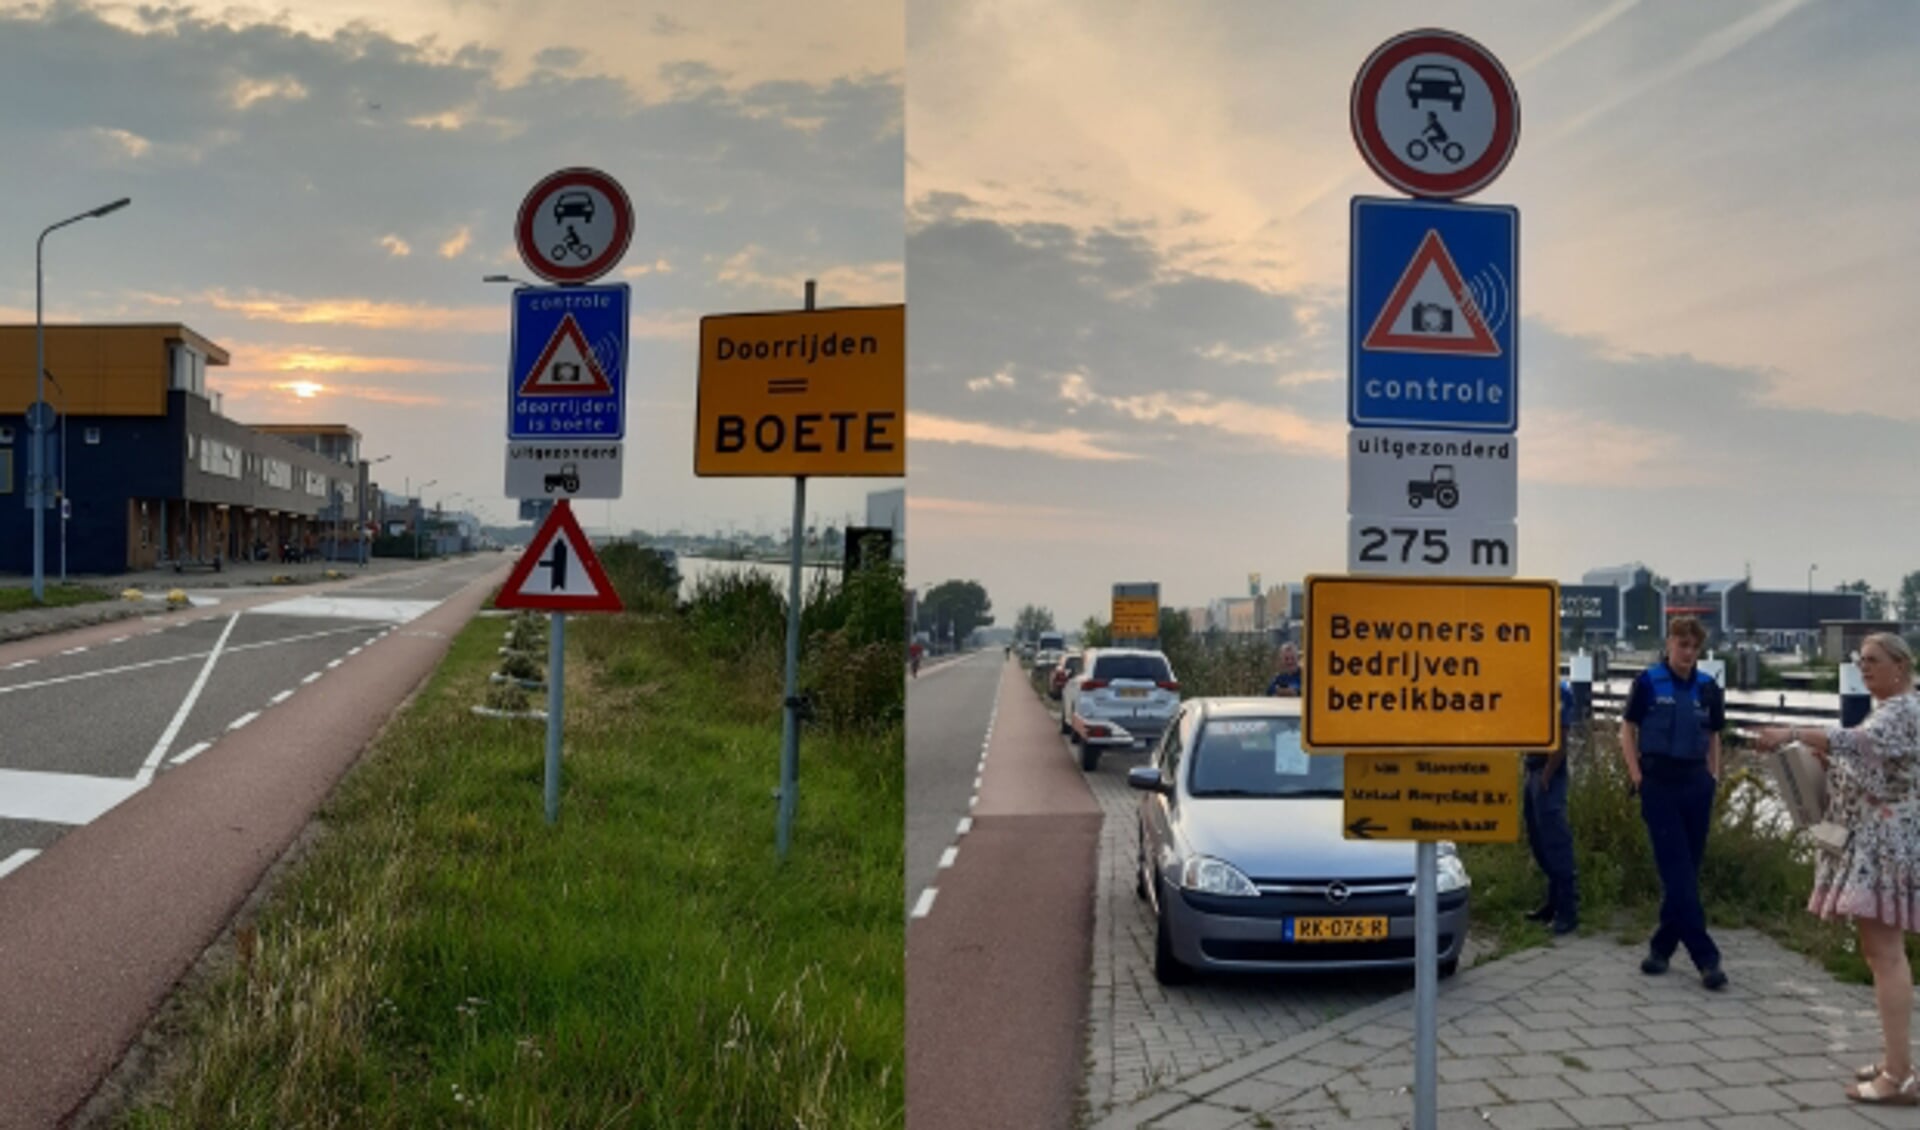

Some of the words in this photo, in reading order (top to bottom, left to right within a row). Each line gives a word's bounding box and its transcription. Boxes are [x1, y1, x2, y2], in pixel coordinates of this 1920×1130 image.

[530, 294, 611, 310] controle
[717, 334, 877, 363] Doorrijden
[1366, 378, 1503, 404] controle
[517, 398, 617, 417] doorrijden
[528, 417, 545, 431] is
[551, 416, 603, 431] boete
[716, 412, 895, 453] BOETE
[511, 445, 618, 460] uitgezonderd
[1358, 437, 1509, 460] uitgezonderd
[1359, 526, 1449, 565] 275
[1471, 538, 1509, 566] m
[1330, 615, 1484, 642] Bewoners
[1496, 623, 1531, 642] en
[1328, 651, 1479, 682] bedrijven
[1328, 687, 1502, 711] bereikbaar
